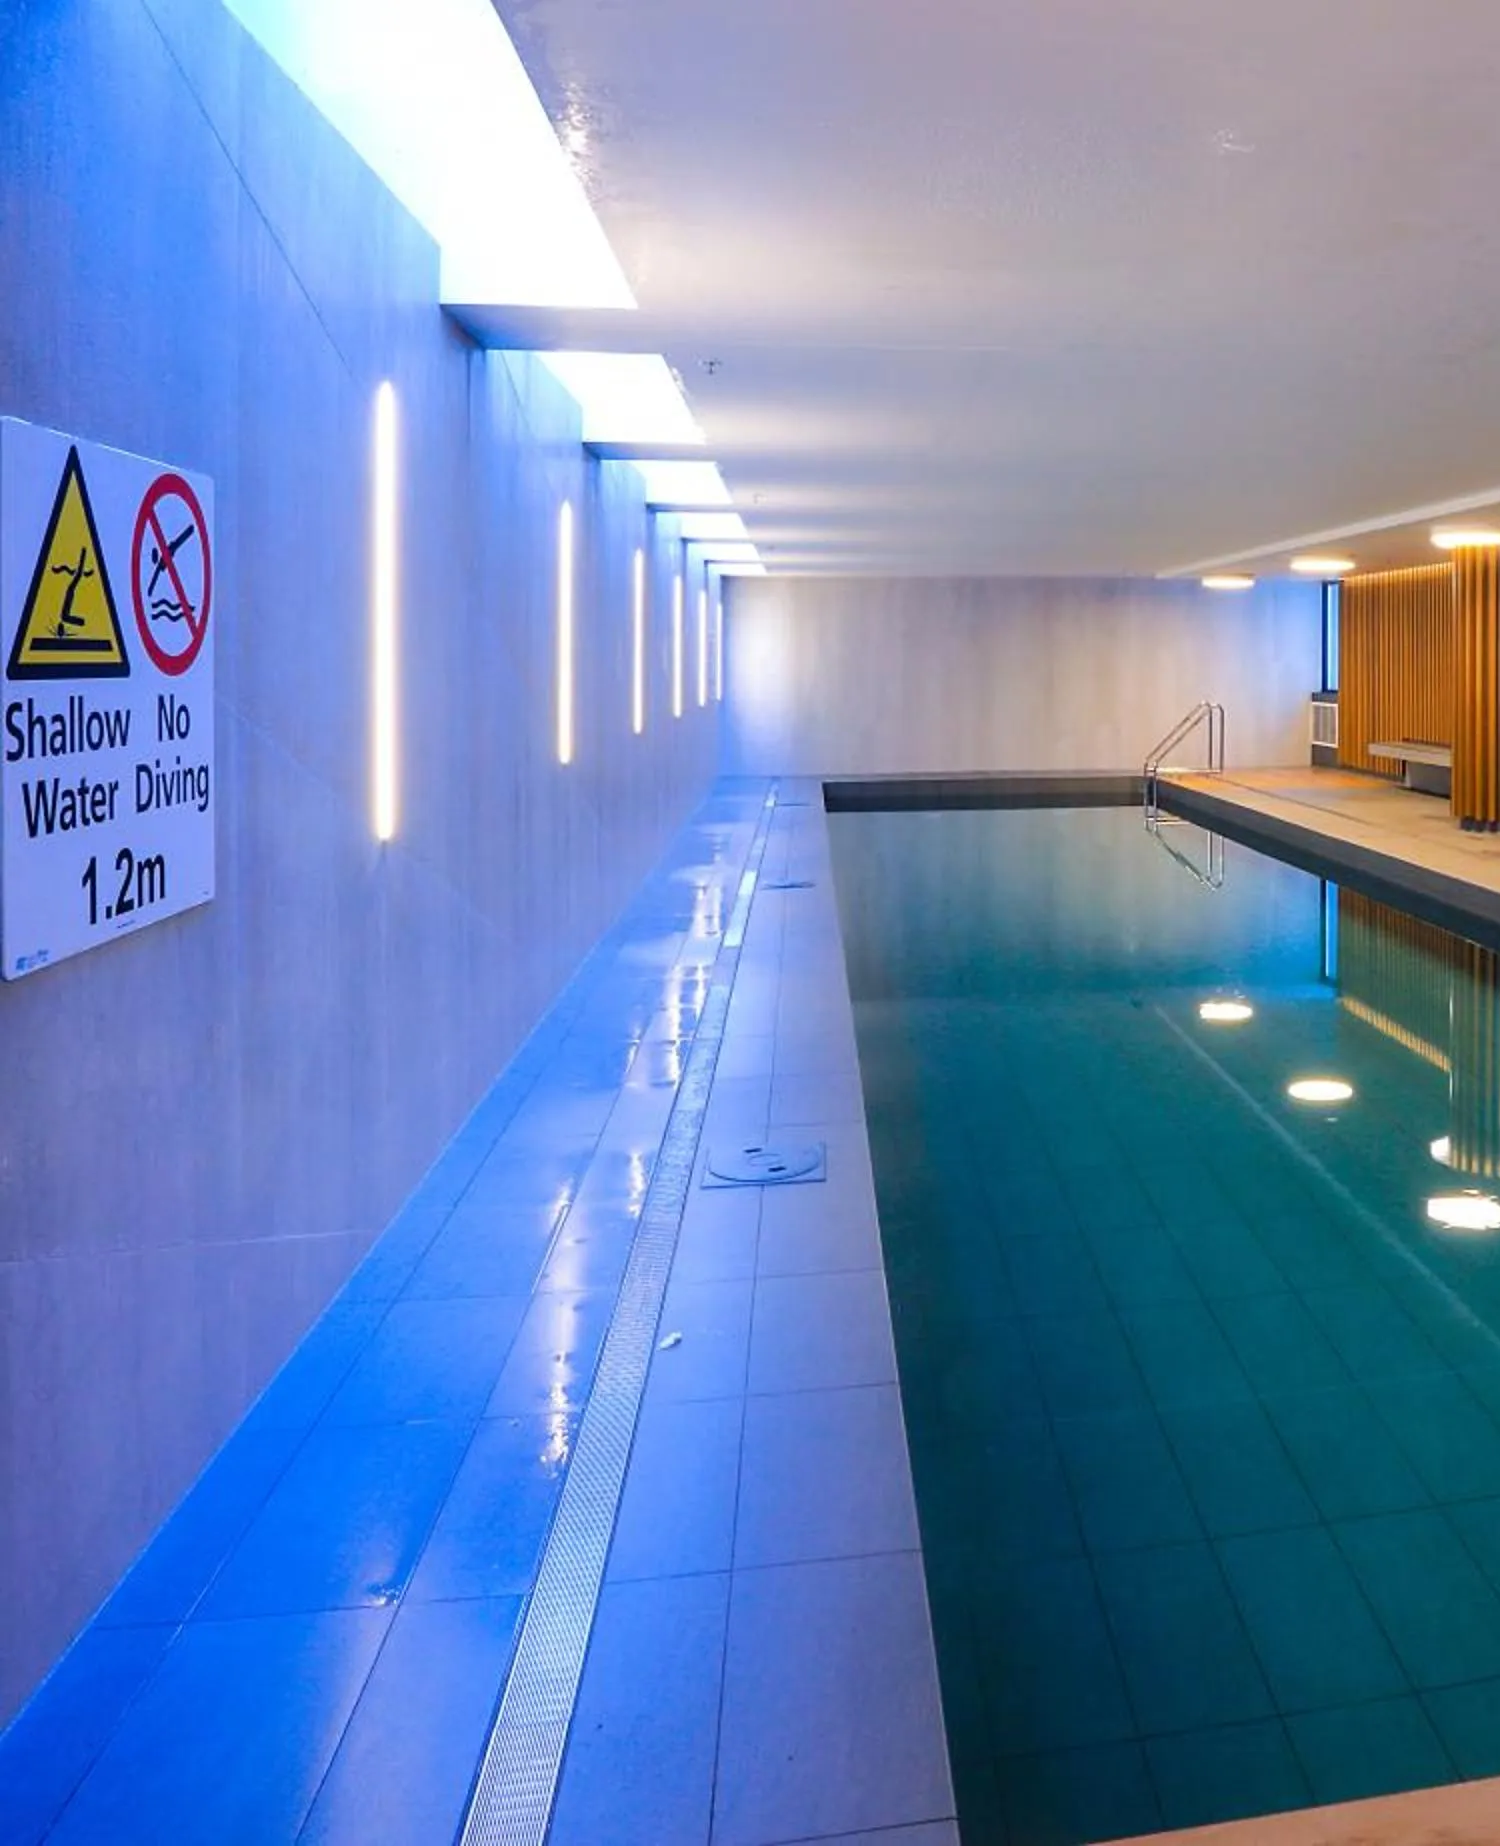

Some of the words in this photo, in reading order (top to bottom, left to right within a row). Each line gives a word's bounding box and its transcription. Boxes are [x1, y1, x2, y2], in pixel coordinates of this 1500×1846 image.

[5, 695, 131, 762] Shallow
[157, 693, 191, 743] No
[22, 776, 119, 839] Water
[135, 756, 209, 814] Diving
[81, 847, 165, 925] 1.2m
